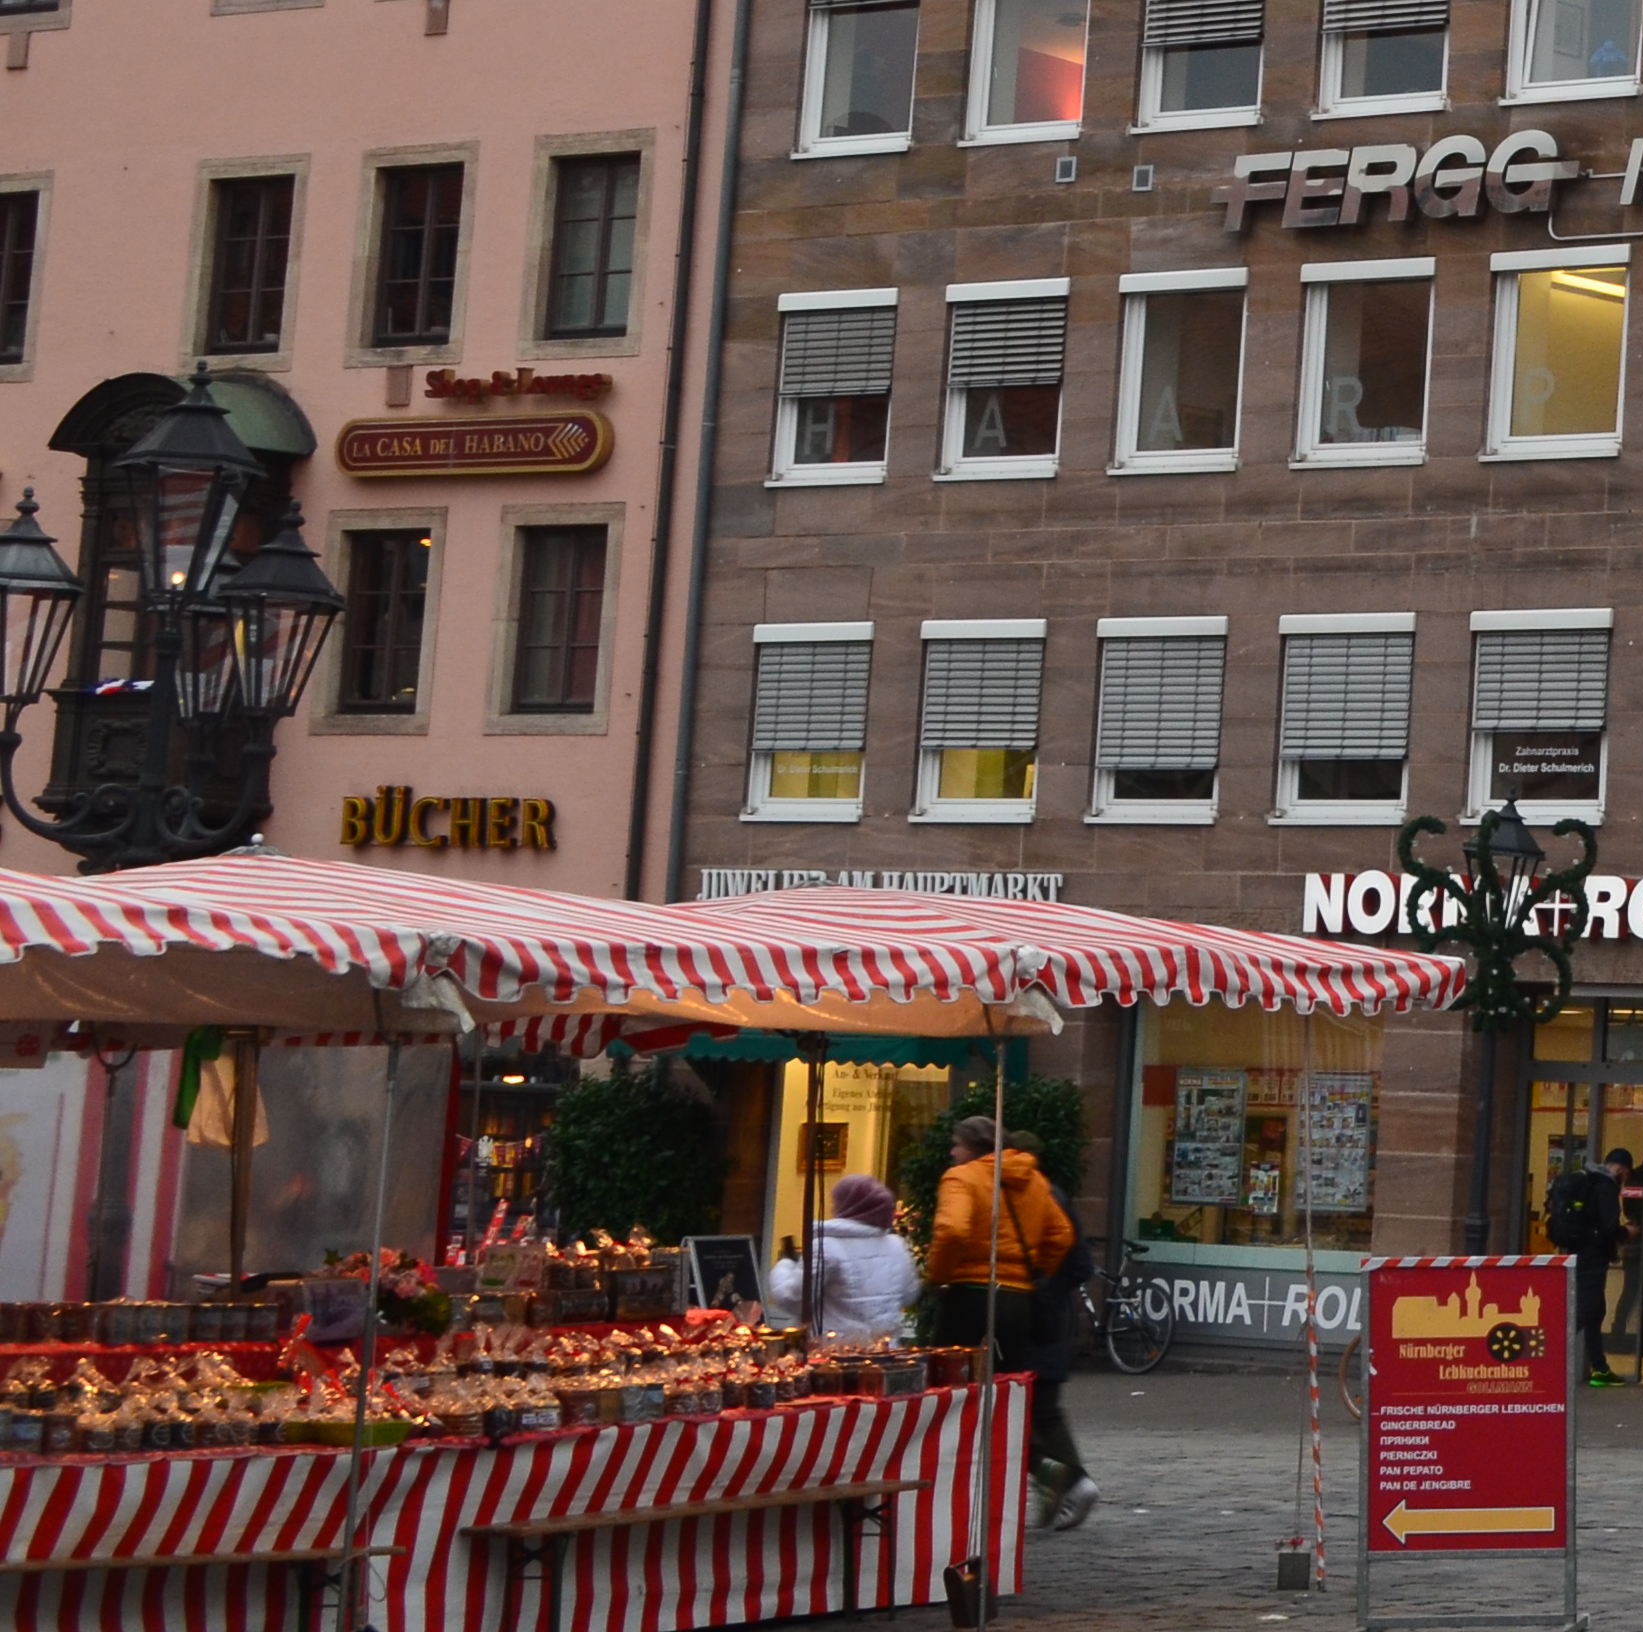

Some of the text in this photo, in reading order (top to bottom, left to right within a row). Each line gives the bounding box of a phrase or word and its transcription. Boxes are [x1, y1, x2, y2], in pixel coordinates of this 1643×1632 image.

[1211, 129, 1580, 232] FERGG
[352, 432, 545, 458] LA CASA DEL HABANO
[1515, 745, 1580, 759] Zahnarztpraxis
[1499, 762, 1595, 775] Dr. Dieter Schulmerich
[340, 785, 553, 850] BÜCHER
[881, 872, 1063, 902] HAUPTMARKT
[1399, 1344, 1466, 1360] Nürnberger
[1439, 1363, 1530, 1380] Lebkuchenhaus
[1380, 1403, 1566, 1416] FRISCHE NÜRNBERGER LEBKUCHEN
[1380, 1420, 1456, 1431] GINGERBREAD
[1380, 1435, 1430, 1446] ПРЯНИКИ
[1380, 1450, 1437, 1461] PIERNICZKI
[1380, 1465, 1444, 1475] PAN PEPATO
[1380, 1479, 1472, 1491] PAN DE JENGIBRE
